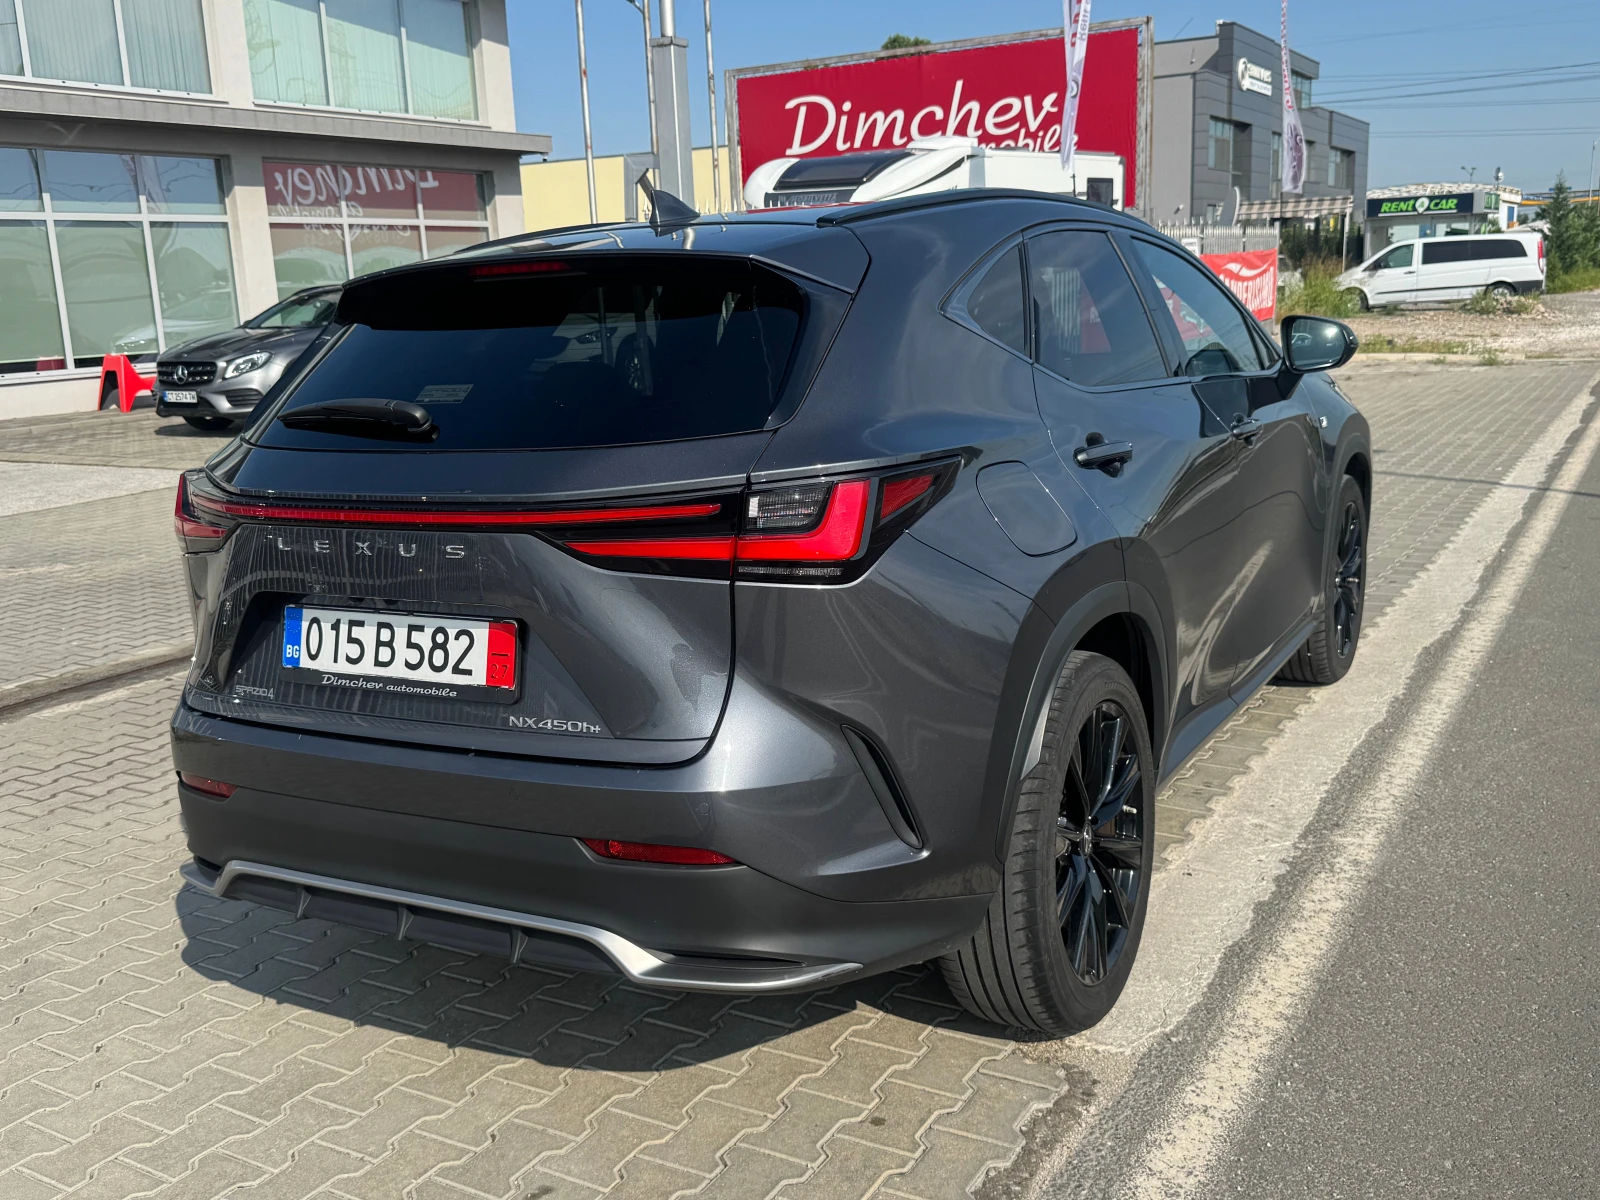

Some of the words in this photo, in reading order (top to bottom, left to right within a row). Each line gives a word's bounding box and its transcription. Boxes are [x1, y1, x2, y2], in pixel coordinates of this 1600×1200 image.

[785, 79, 1058, 156] Dimchev
[1430, 198, 1458, 210] CAR
[277, 537, 465, 559] LEXUS
[286, 644, 300, 659] BG
[321, 674, 384, 689] Dimchev
[386, 684, 457, 698] automobile
[508, 715, 602, 734] NX450h+
